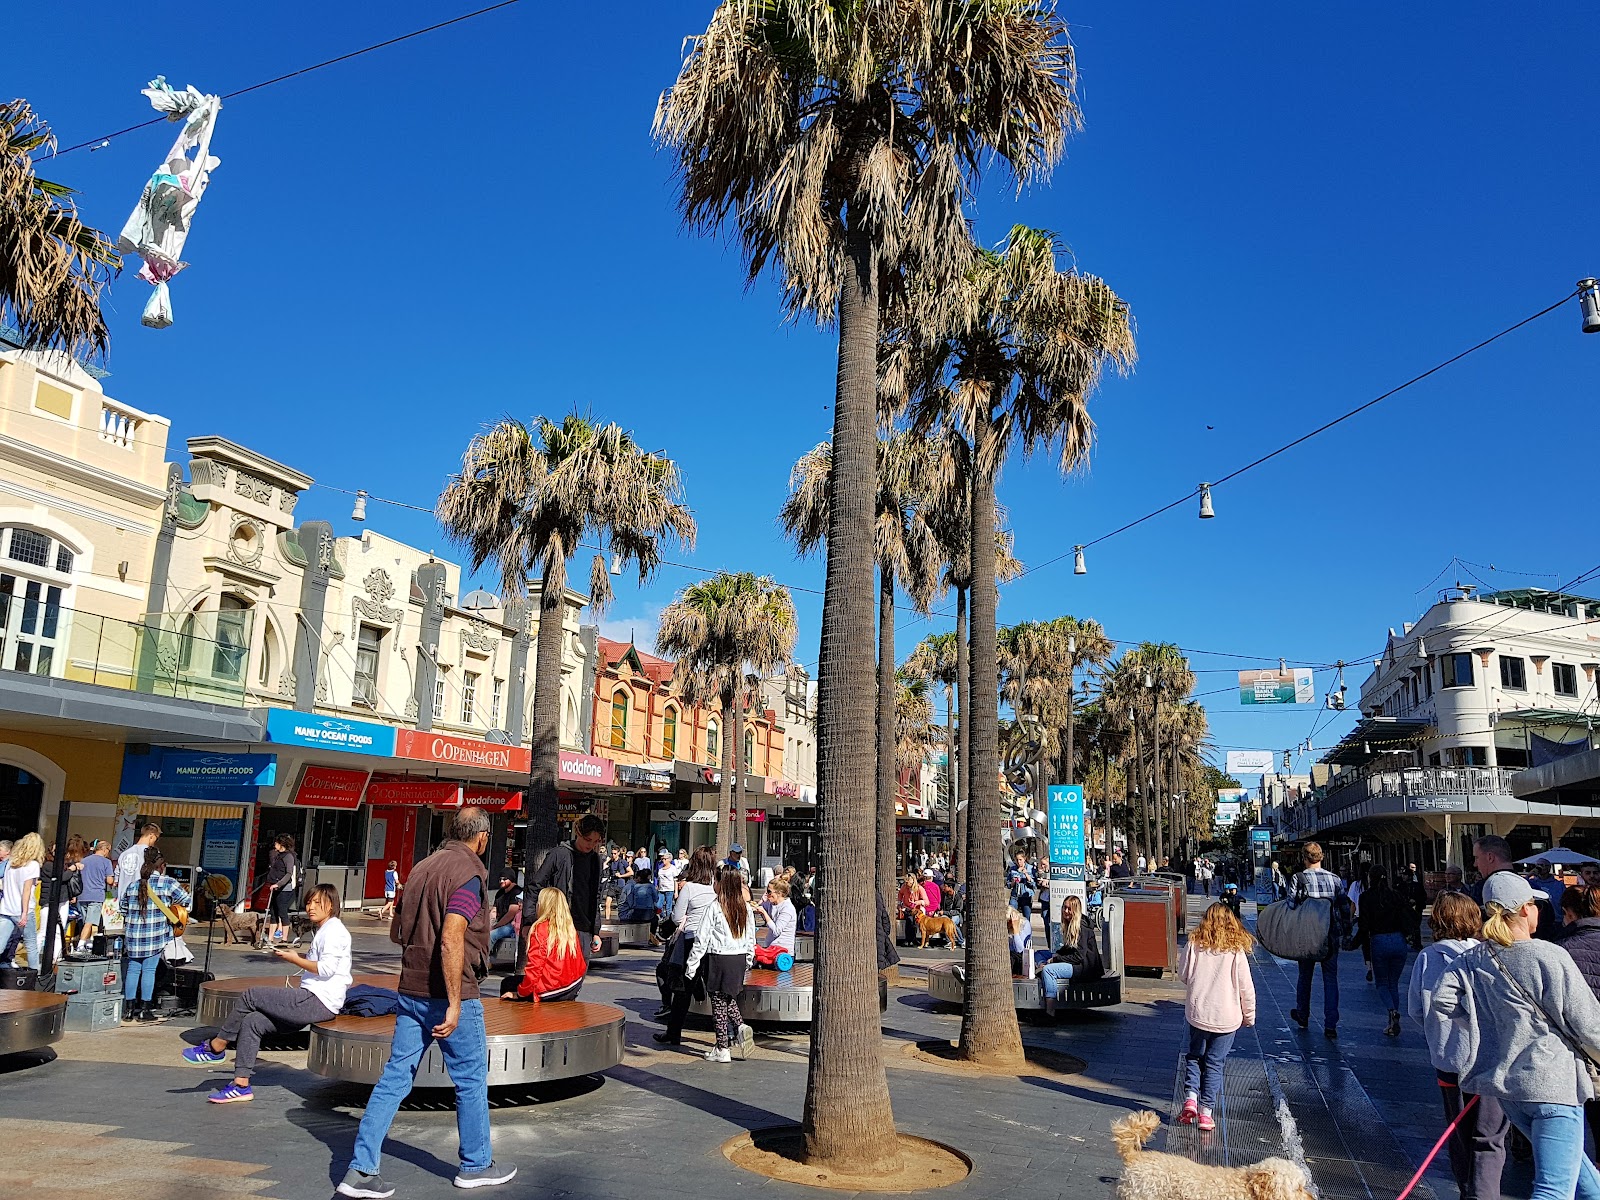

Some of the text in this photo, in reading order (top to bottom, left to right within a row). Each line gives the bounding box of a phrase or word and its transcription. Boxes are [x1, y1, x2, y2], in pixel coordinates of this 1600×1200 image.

[295, 726, 321, 738] MANLY
[321, 730, 347, 741] OCEAN
[348, 734, 372, 744] FOODS
[432, 738, 510, 767] COPENHAGEN
[561, 759, 602, 777] vodafone
[304, 776, 364, 792] COPENHAGEN
[378, 788, 445, 799] COPENHAGEN
[466, 796, 505, 804] vodafone
[1051, 866, 1082, 877] manly
